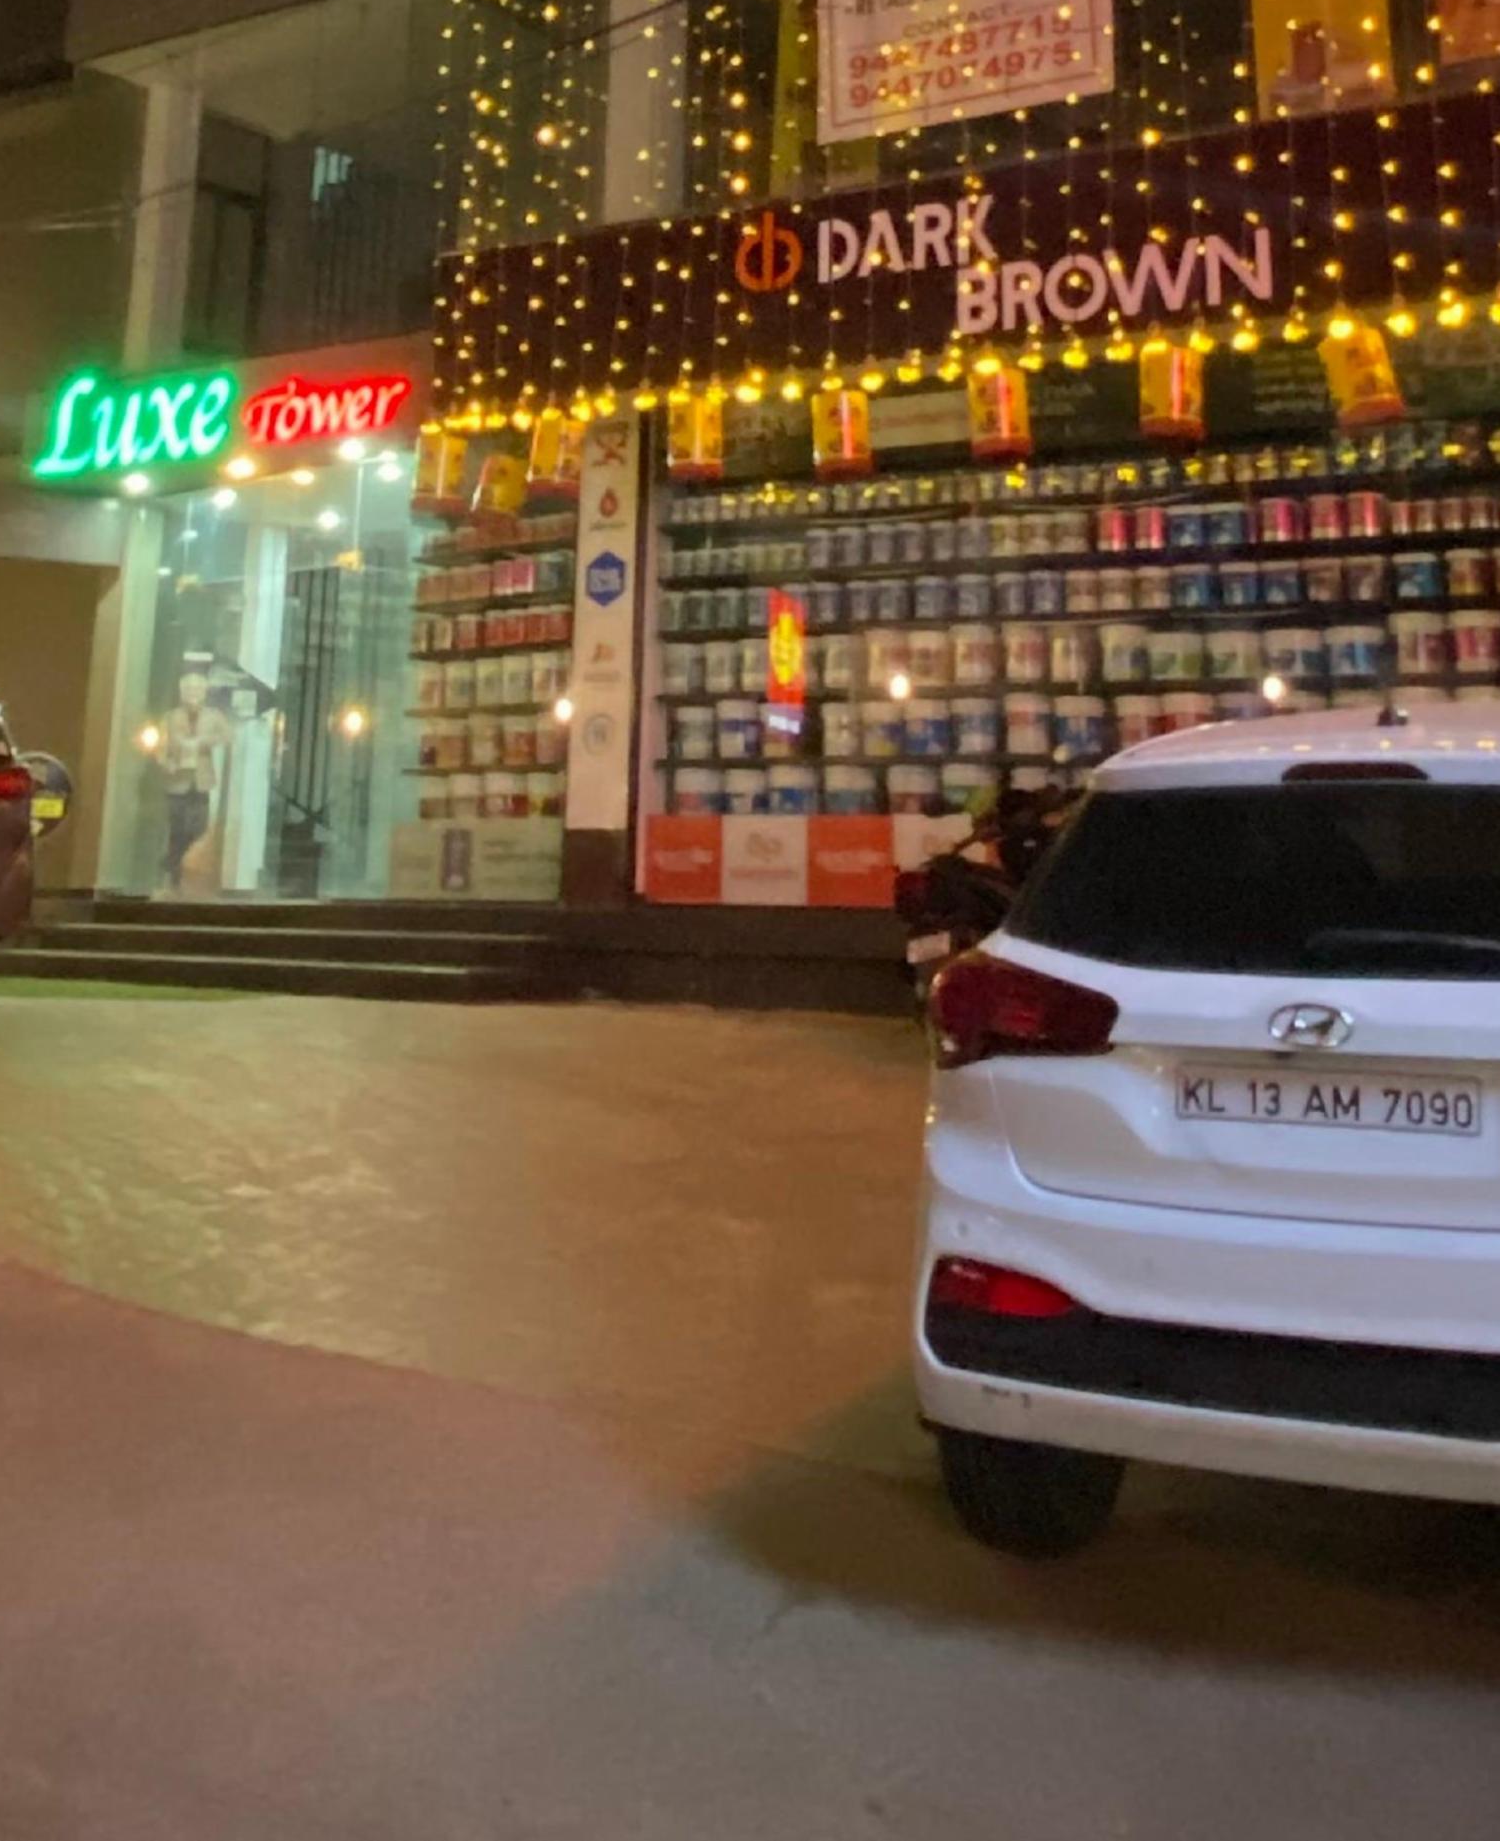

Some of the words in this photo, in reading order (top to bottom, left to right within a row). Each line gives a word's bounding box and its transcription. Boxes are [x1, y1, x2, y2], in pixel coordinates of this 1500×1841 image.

[817, 194, 998, 284] DARK
[956, 226, 1273, 334] BROWN
[33, 375, 232, 477] Luxe
[248, 378, 408, 443] Tower
[1182, 1077, 1225, 1114] KL
[1248, 1082, 1281, 1116] 13
[1303, 1085, 1361, 1121] AM
[1383, 1088, 1474, 1129] 7090
